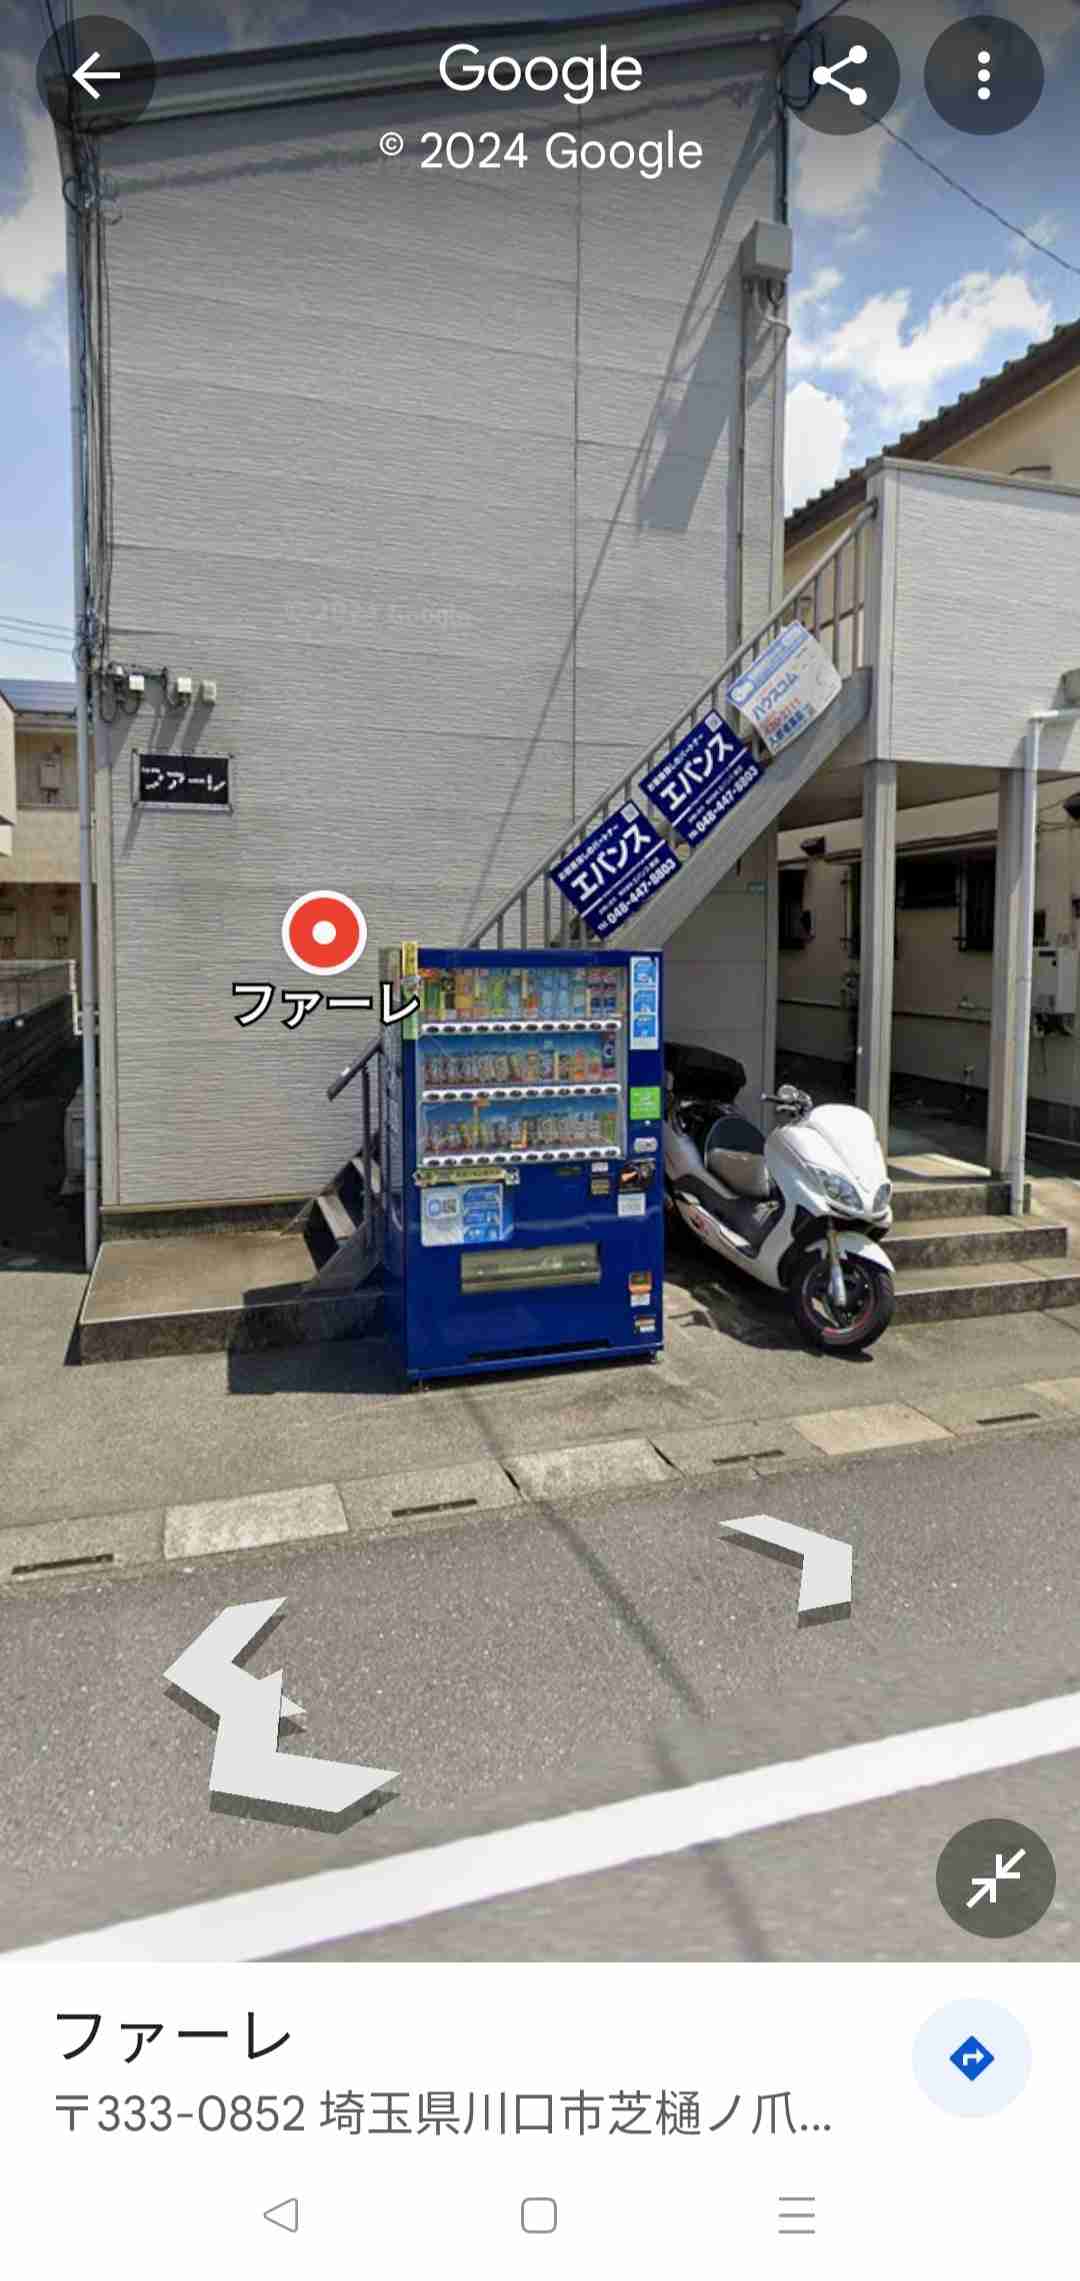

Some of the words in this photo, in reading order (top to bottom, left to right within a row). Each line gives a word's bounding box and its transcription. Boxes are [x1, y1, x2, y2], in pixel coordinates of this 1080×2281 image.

[753, 672, 799, 720] ハウスコム
[659, 732, 734, 812] エバンス
[570, 823, 652, 902] エバンス
